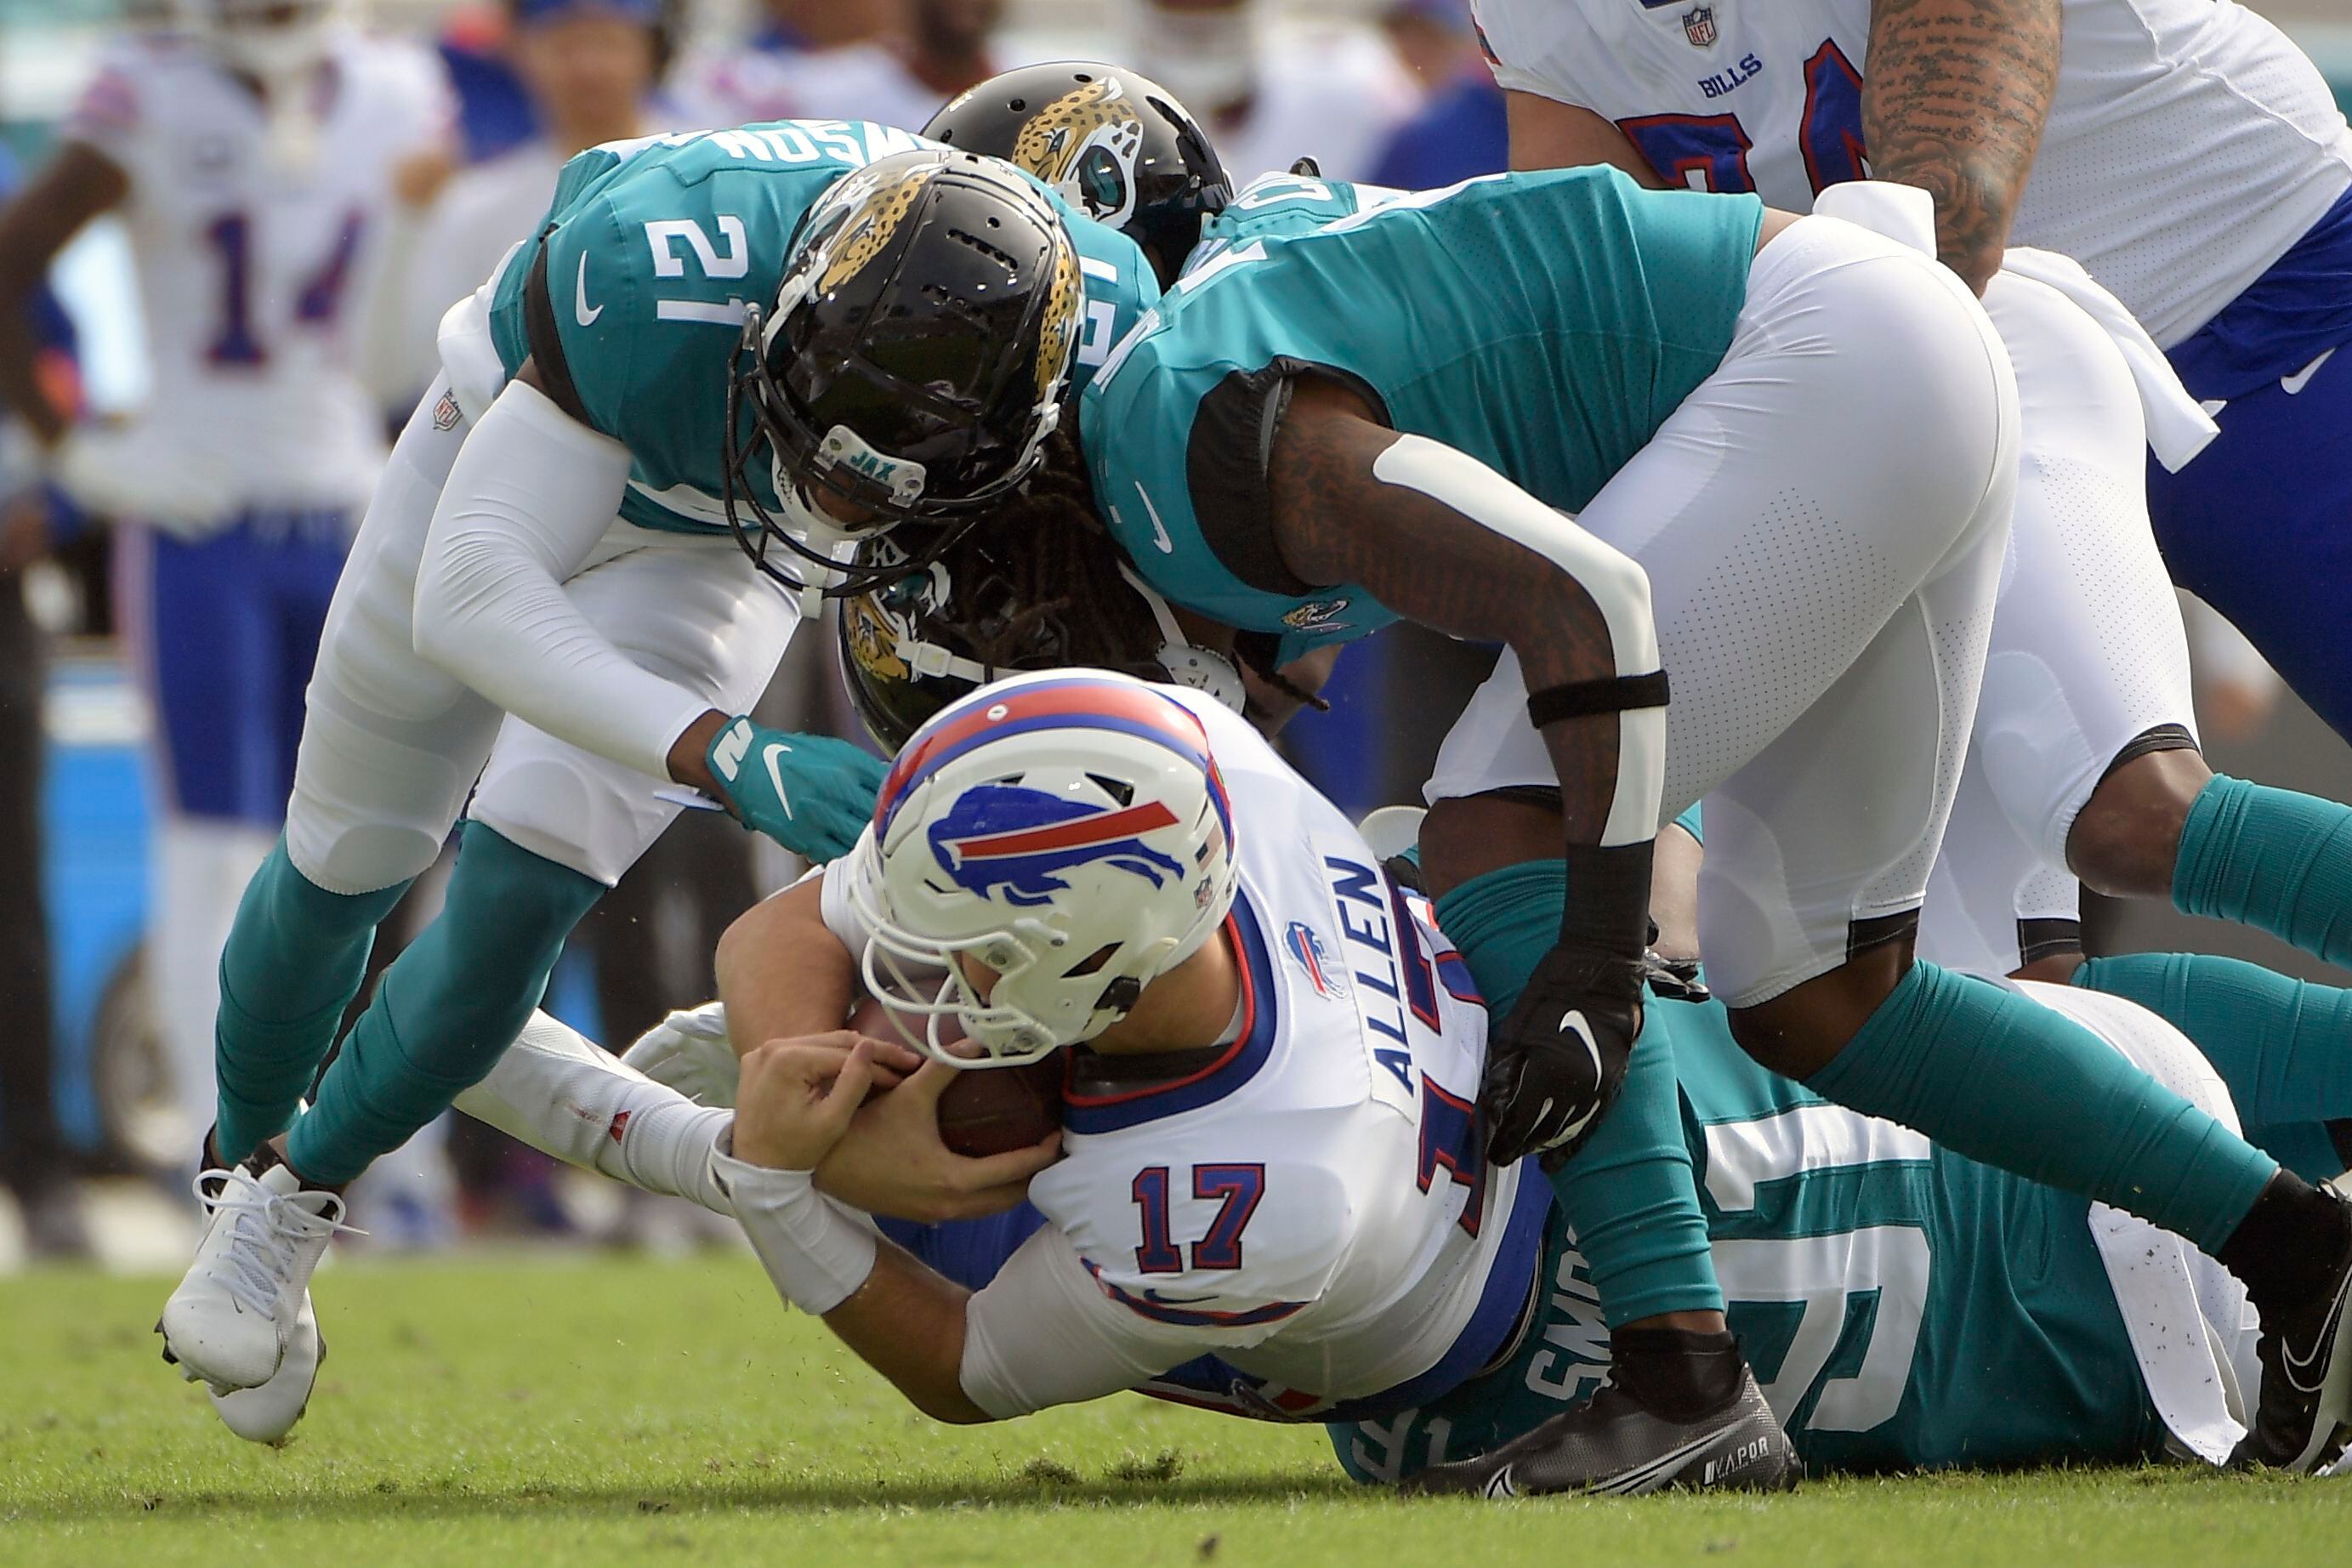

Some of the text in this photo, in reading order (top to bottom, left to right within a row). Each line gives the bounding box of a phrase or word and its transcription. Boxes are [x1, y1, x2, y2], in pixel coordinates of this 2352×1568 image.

[1697, 53, 1763, 99] BILLS
[644, 215, 749, 327] 21
[850, 451, 897, 482] JAX
[1324, 855, 1415, 1099] ALLEN
[1132, 1162, 1266, 1275] 17
[1713, 1435, 1769, 1476] VAPOR
